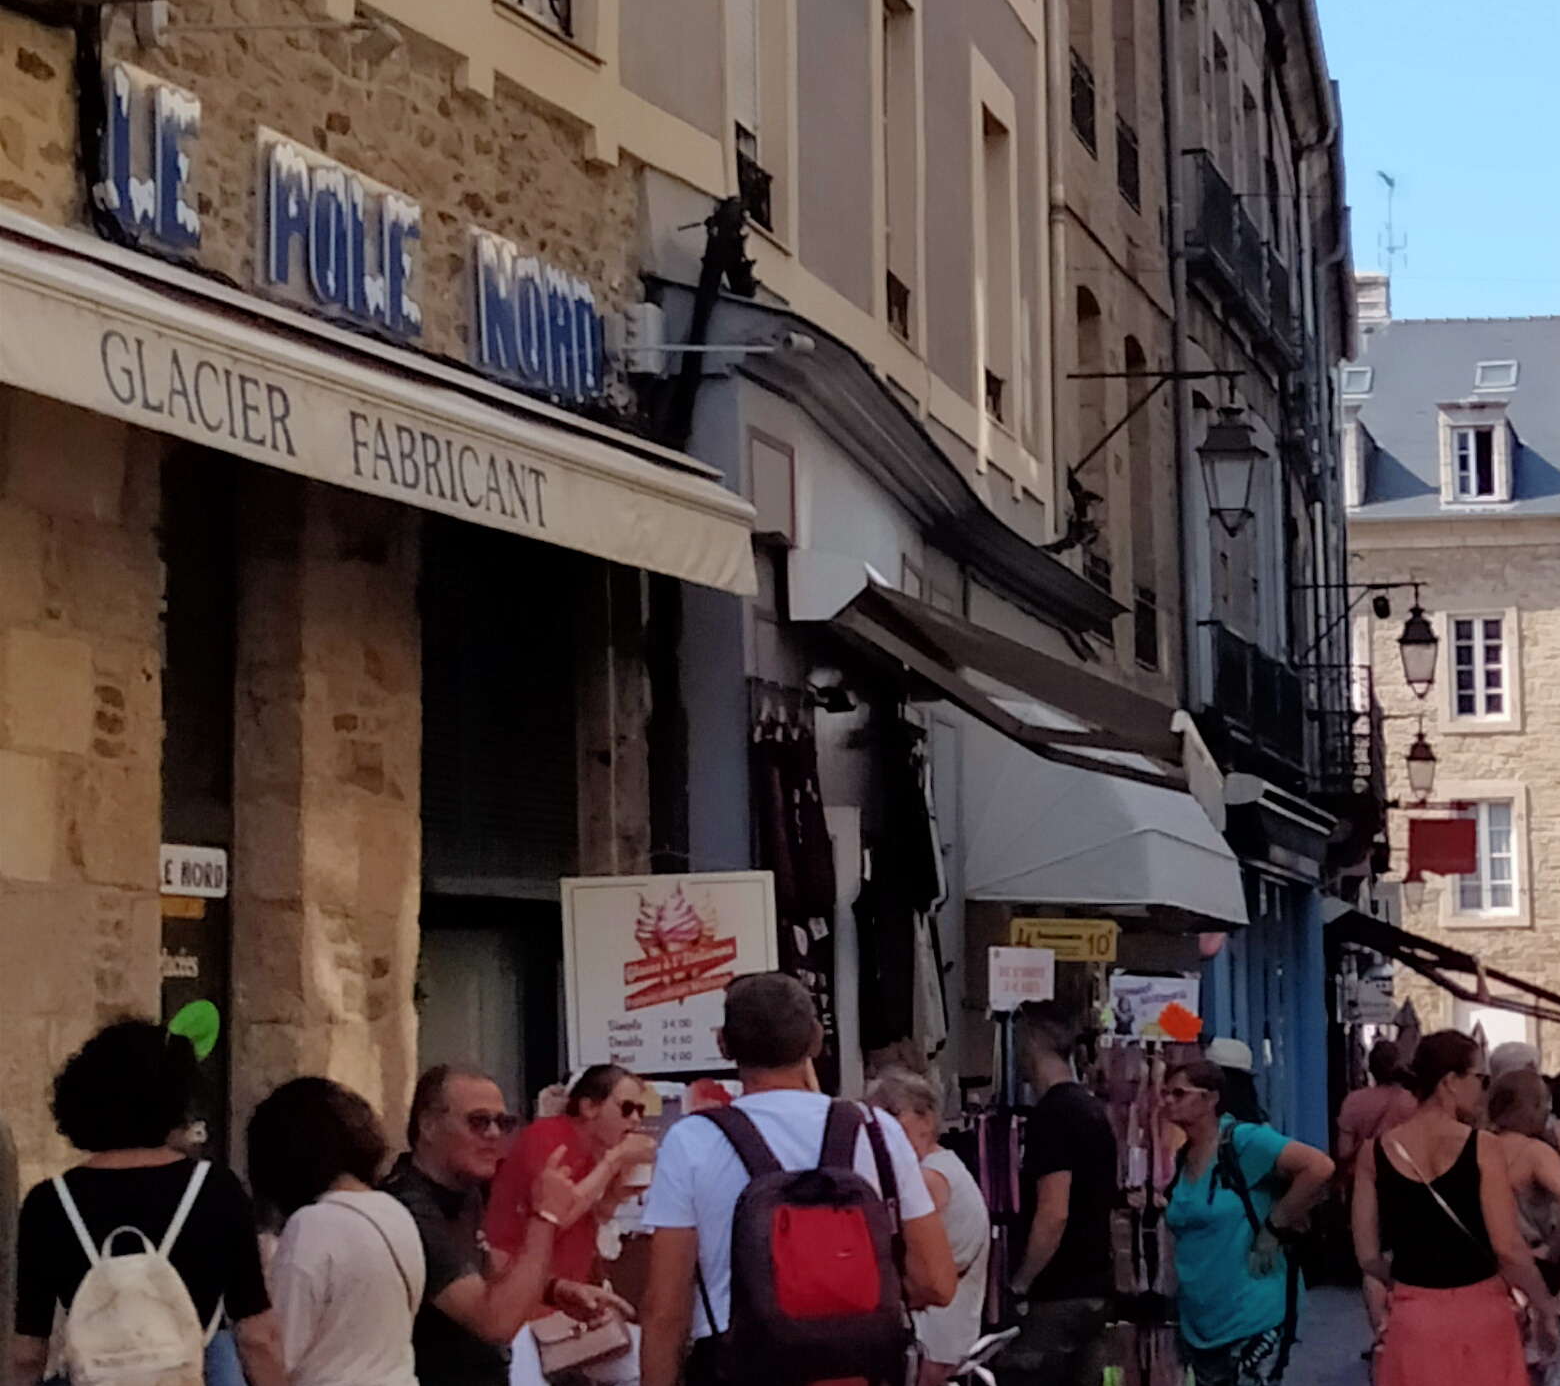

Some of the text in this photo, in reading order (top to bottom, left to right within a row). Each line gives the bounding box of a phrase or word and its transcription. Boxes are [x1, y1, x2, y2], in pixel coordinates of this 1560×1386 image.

[98, 63, 200, 251] LE
[478, 235, 604, 393] NORD
[101, 329, 548, 528] GLACIER FABRICANT
